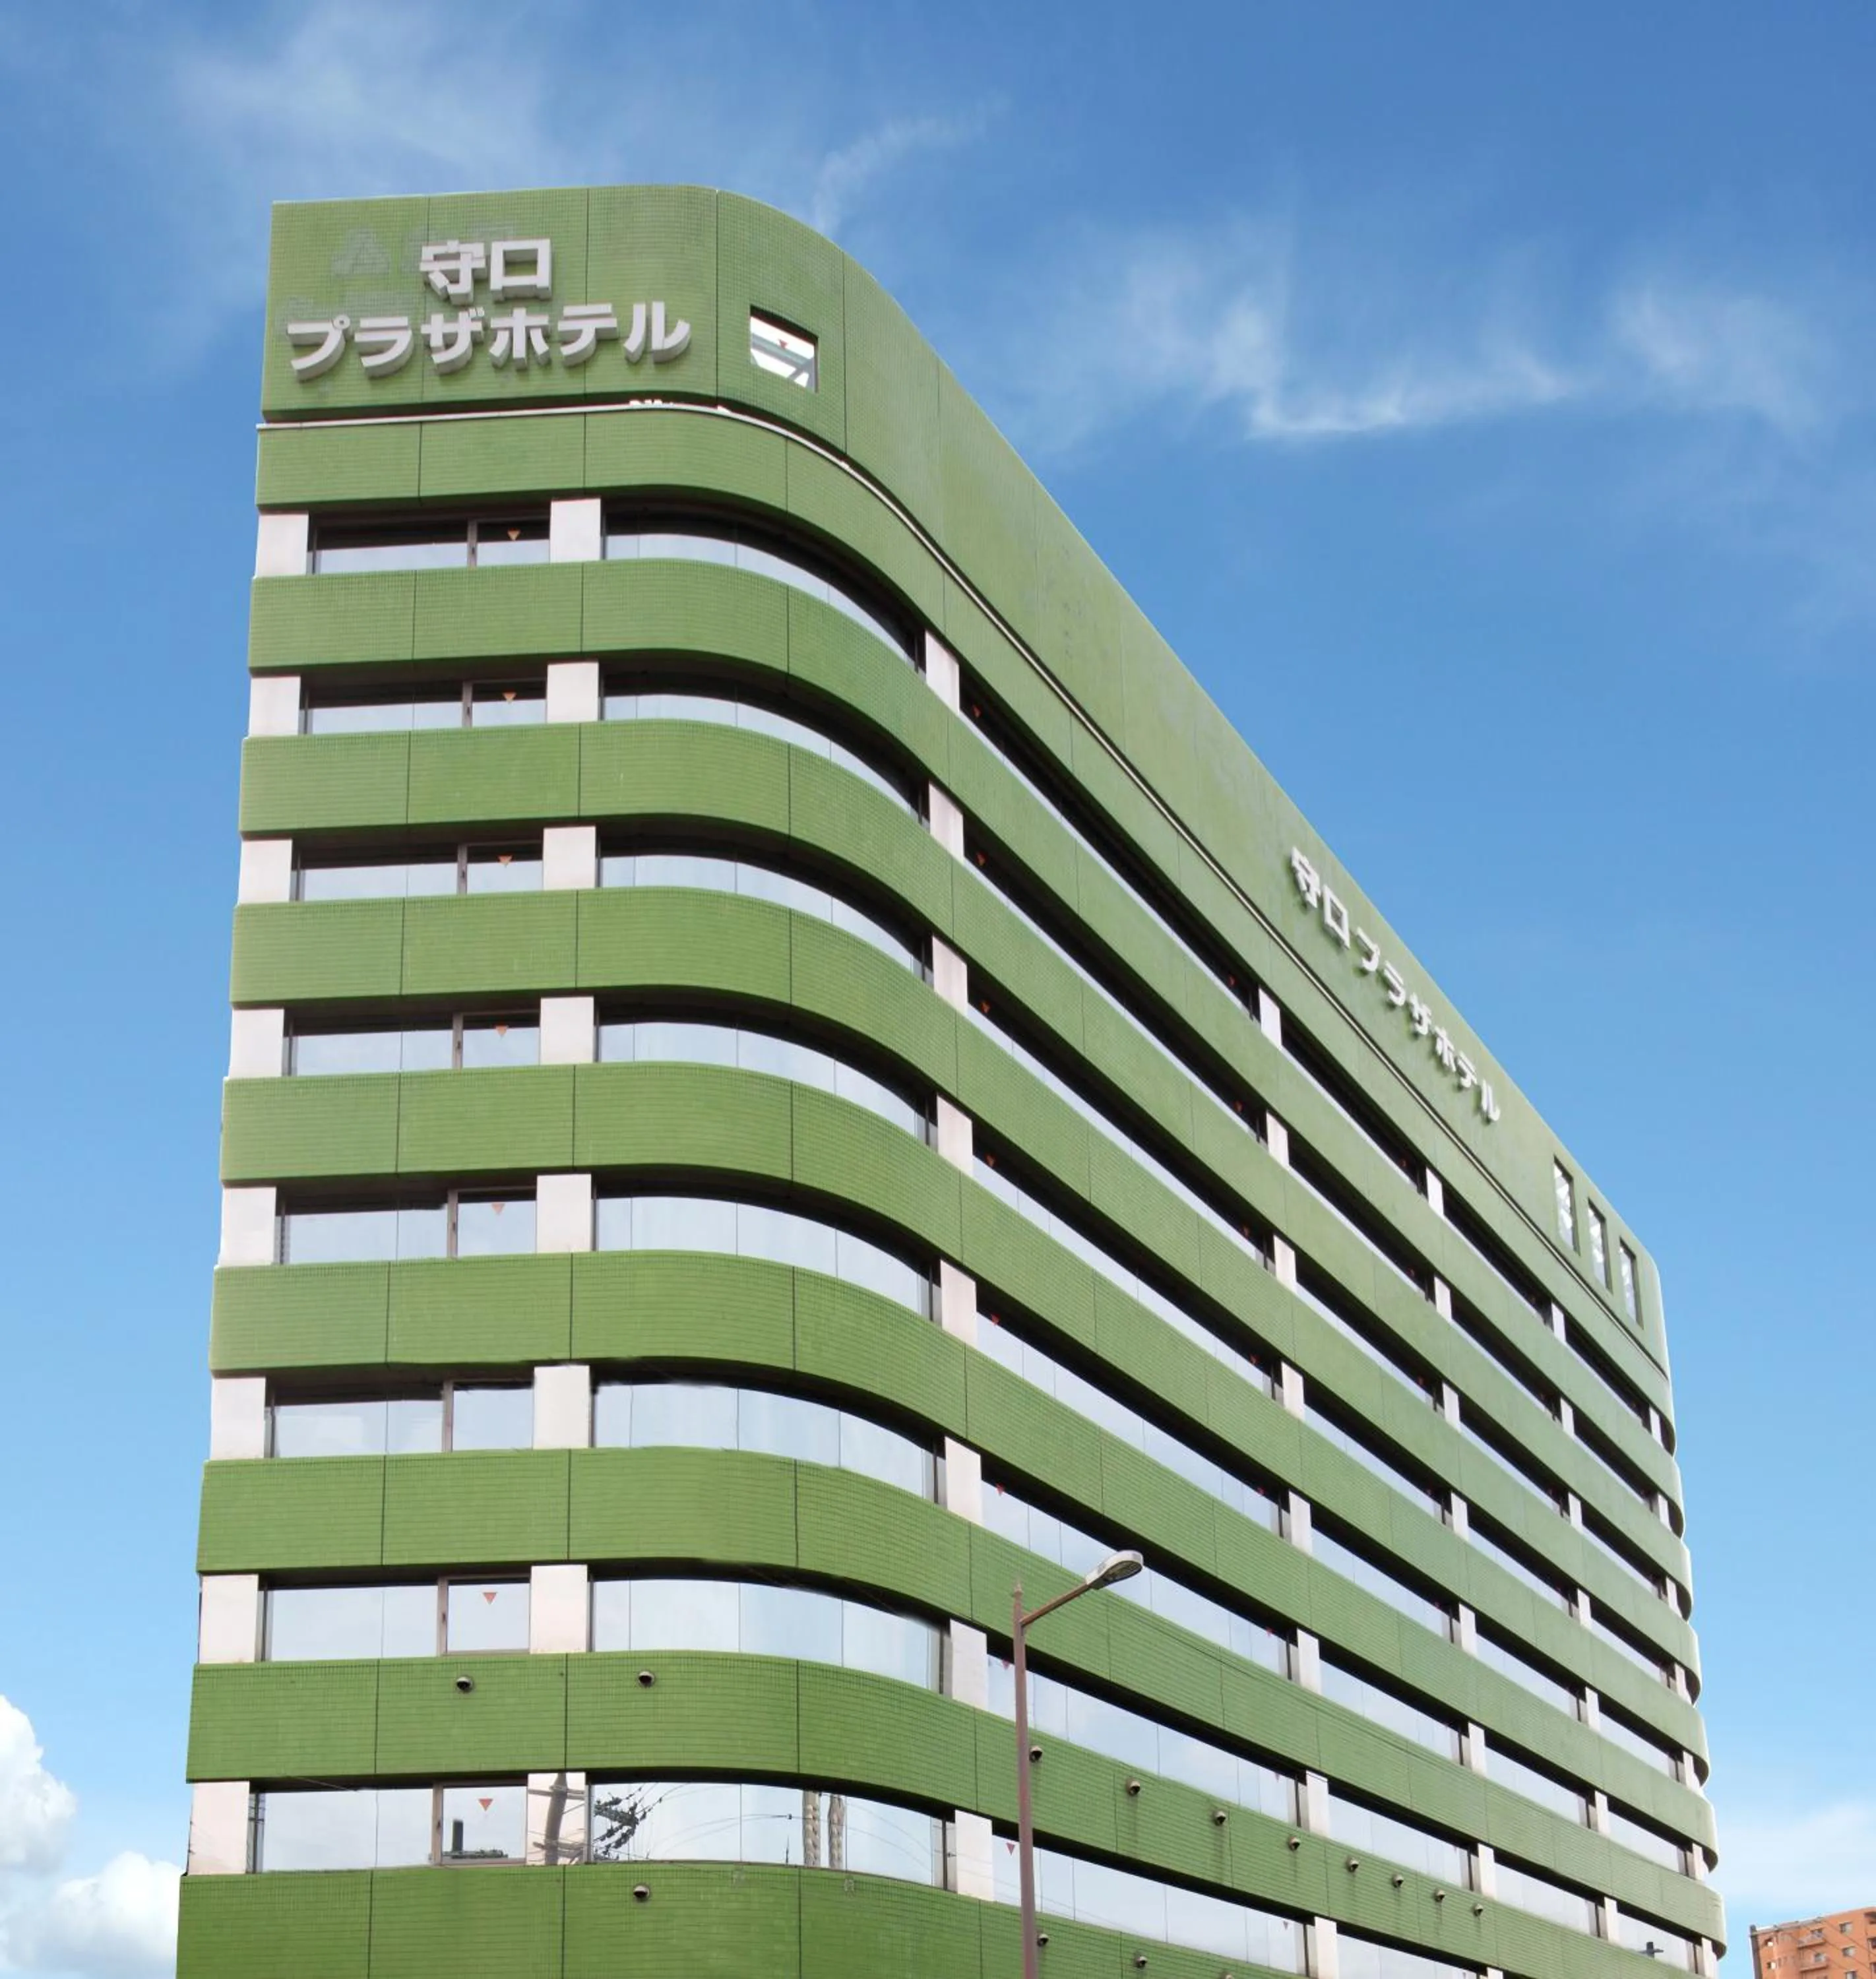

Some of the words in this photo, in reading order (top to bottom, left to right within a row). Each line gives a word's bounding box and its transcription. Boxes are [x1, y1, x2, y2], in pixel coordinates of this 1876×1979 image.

[420, 238, 553, 304] 守口
[287, 301, 691, 381] プラザホテル
